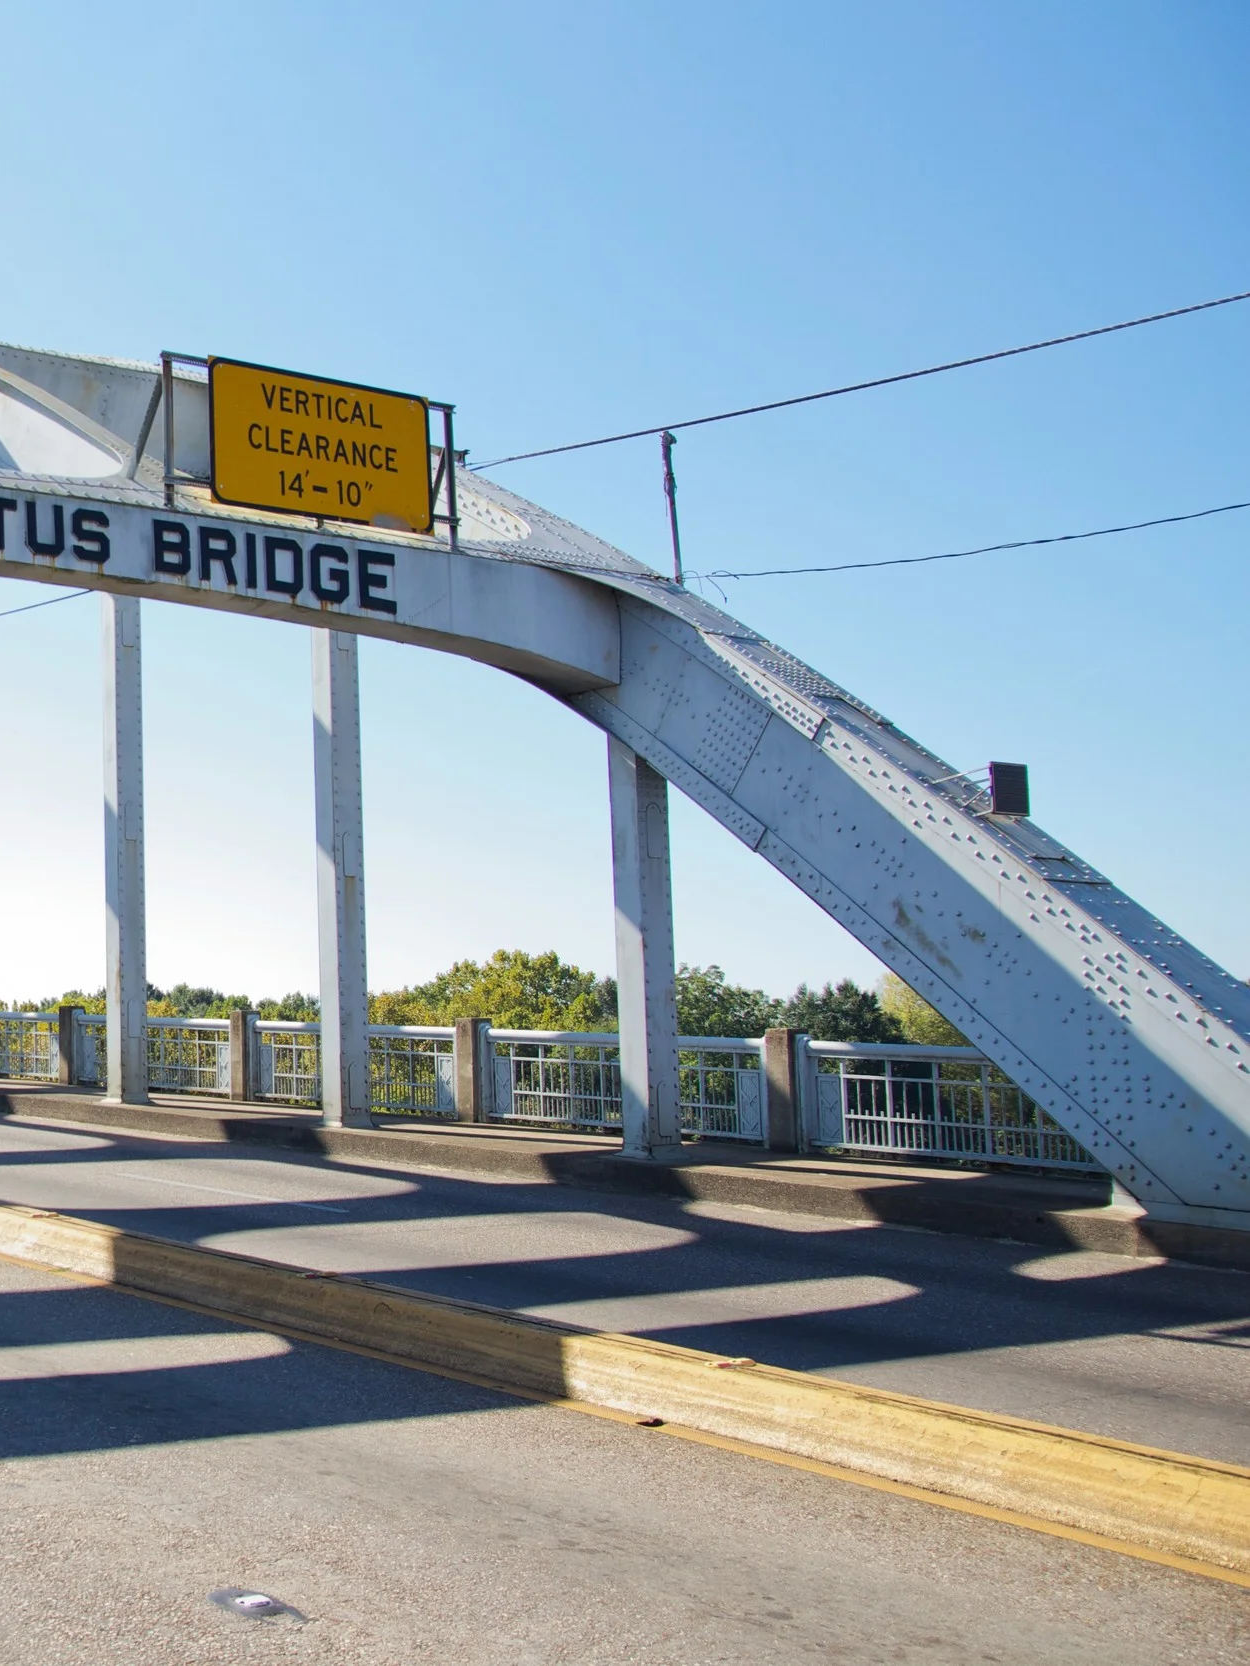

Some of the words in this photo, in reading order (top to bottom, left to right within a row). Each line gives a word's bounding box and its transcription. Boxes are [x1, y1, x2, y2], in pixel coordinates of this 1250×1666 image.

[261, 383, 383, 429] VERTICAL
[248, 423, 398, 473] CLEARANCE
[153, 519, 397, 615] BRIDGE
